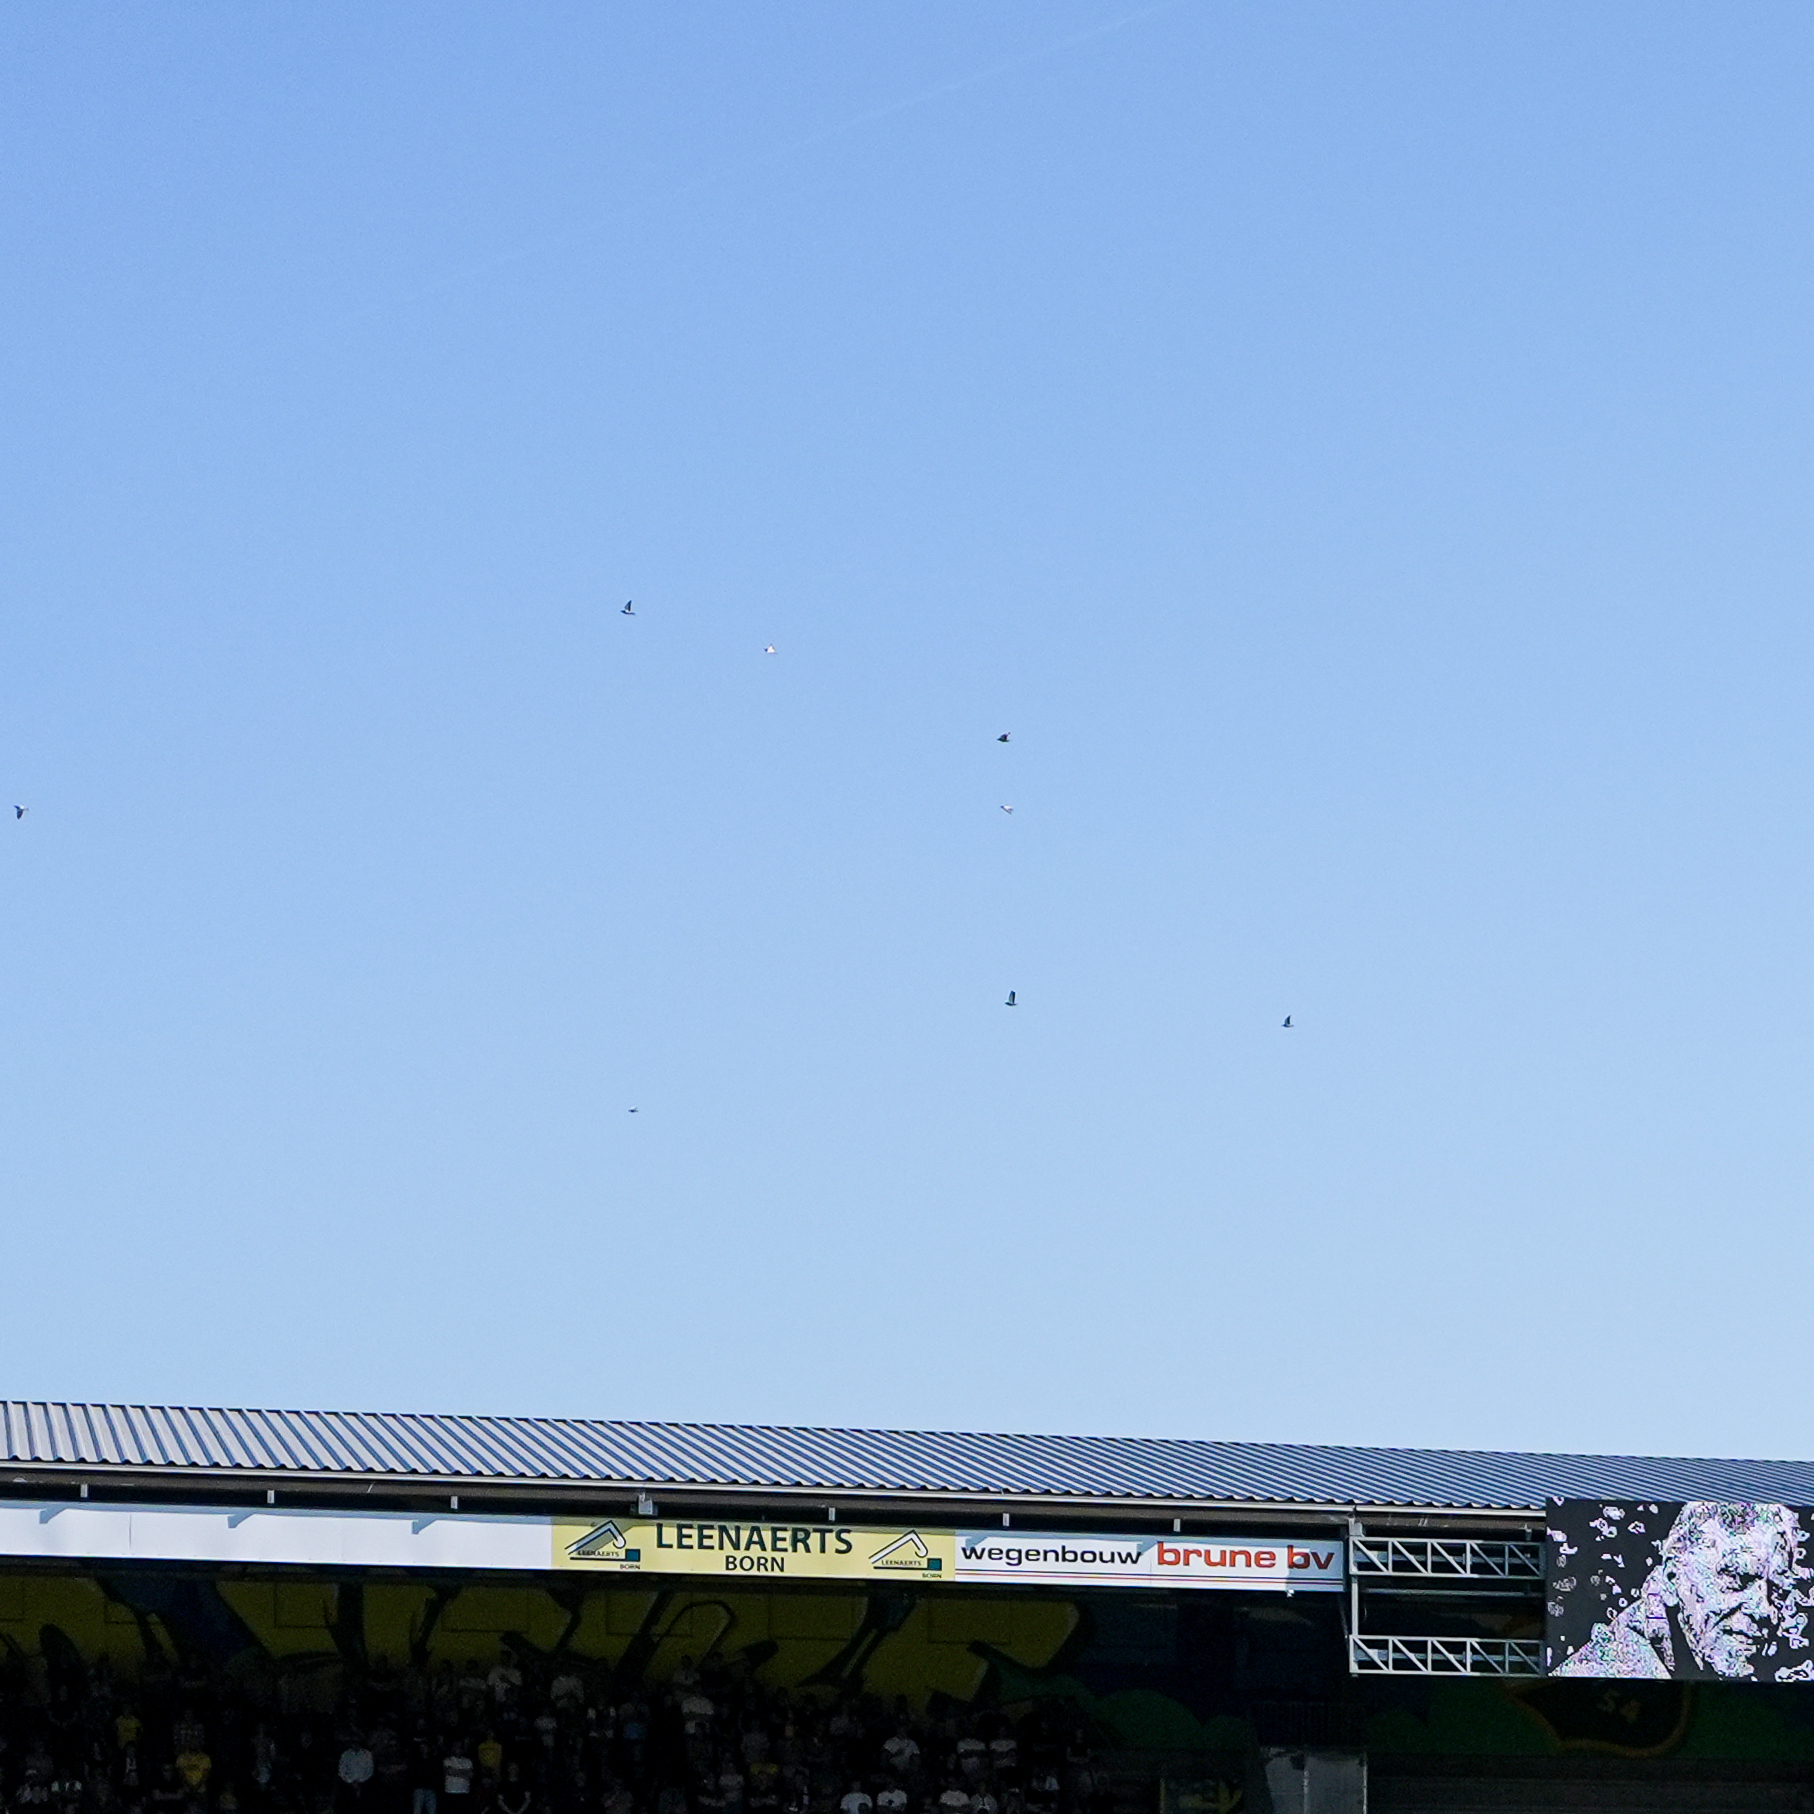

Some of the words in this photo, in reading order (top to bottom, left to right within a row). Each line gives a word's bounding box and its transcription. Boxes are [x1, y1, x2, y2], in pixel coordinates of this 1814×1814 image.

[655, 1522, 853, 1554] LEENAERTS
[725, 1555, 785, 1573] BORN
[880, 1559, 922, 1567] LEENAERTS
[961, 1544, 1143, 1567] wegenbouw
[1157, 1541, 1276, 1569] brune
[1287, 1544, 1335, 1571] bv
